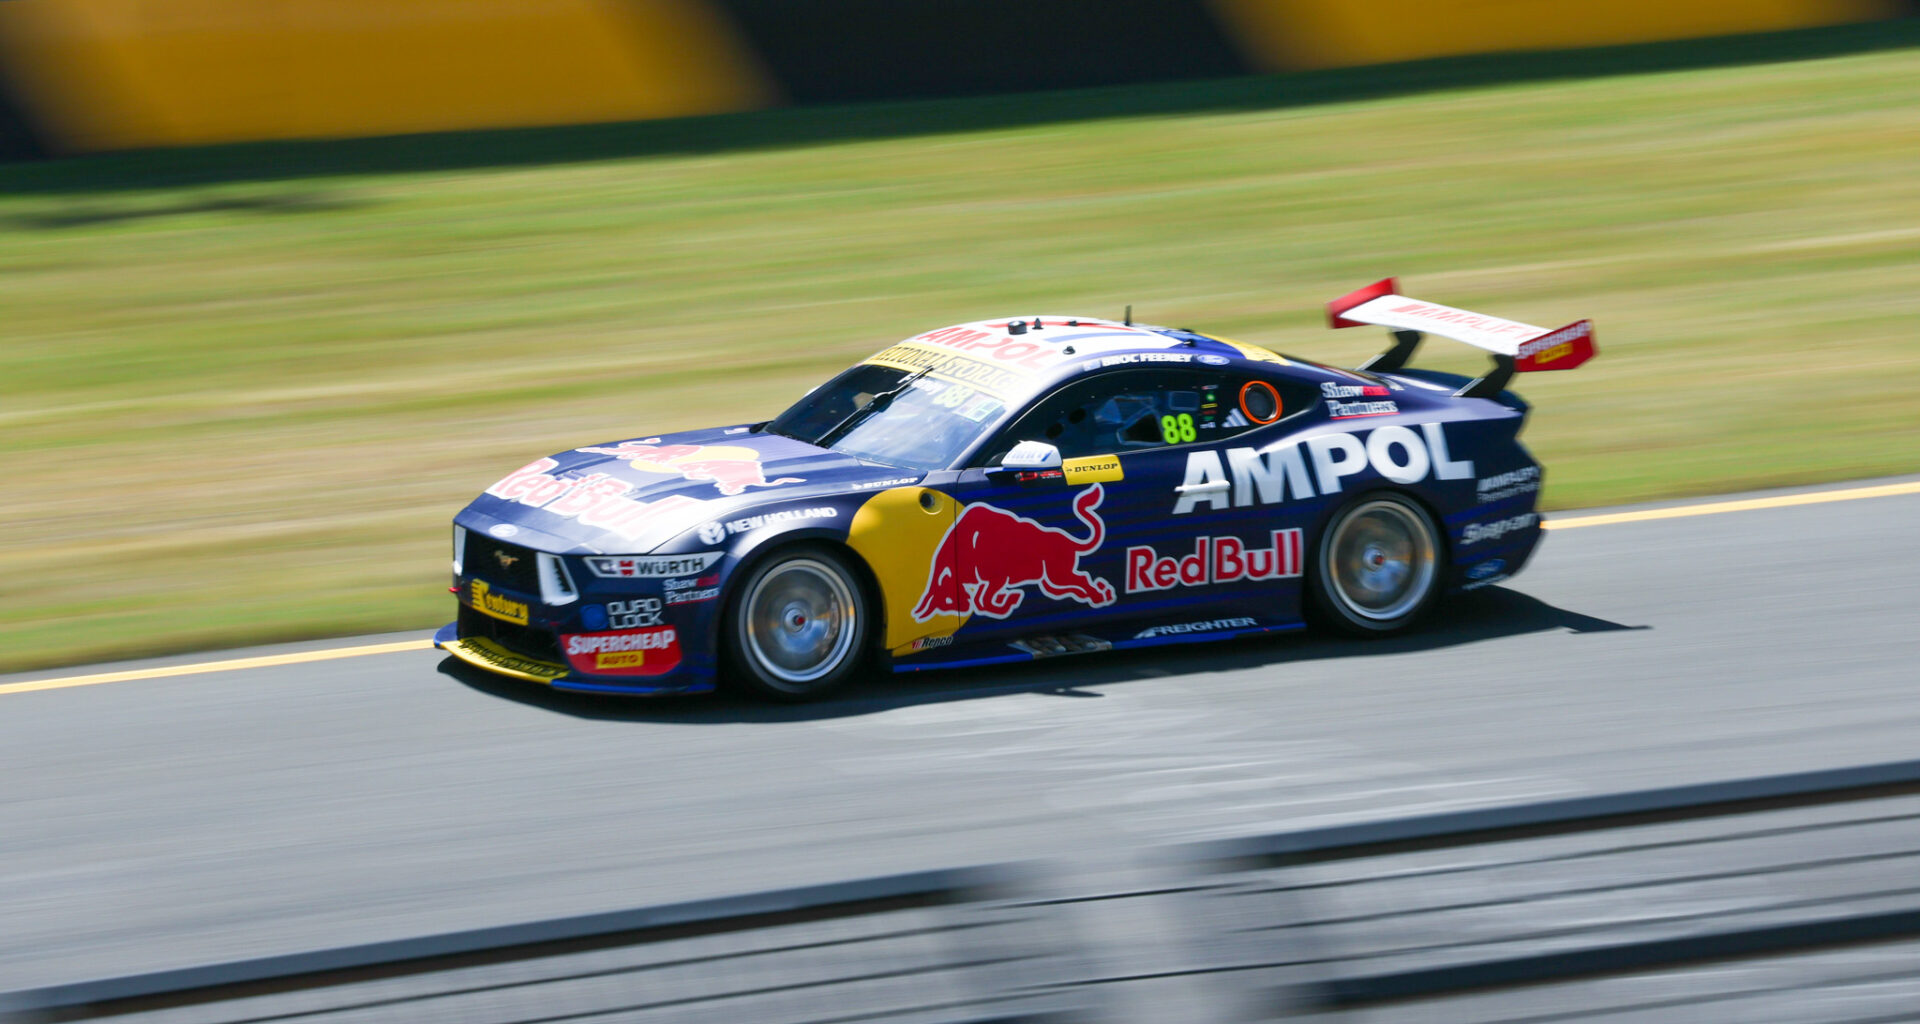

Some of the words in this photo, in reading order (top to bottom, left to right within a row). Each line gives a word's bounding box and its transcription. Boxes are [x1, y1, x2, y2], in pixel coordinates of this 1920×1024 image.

[916, 326, 1056, 370] AMPOL
[1141, 353, 1192, 362] FEENEY
[1161, 413, 1197, 444] 88
[1074, 463, 1118, 473] DUNLOP
[1172, 423, 1475, 514] AMPOL
[485, 457, 605, 507] Red
[863, 477, 918, 489] DUNLOP
[543, 477, 701, 541] Bull
[728, 514, 766, 534] NEW
[766, 507, 838, 524] HOLLAND
[638, 557, 705, 576] WÜRTH
[1126, 537, 1210, 594] Red
[1213, 528, 1304, 583] Bull
[606, 597, 662, 615] QUAD
[608, 611, 664, 630] LOCK
[1152, 617, 1258, 635] FREIGHTER
[566, 629, 676, 655] SUPERCHEAP
[922, 637, 953, 648] Repco
[600, 655, 640, 665] AUTO
